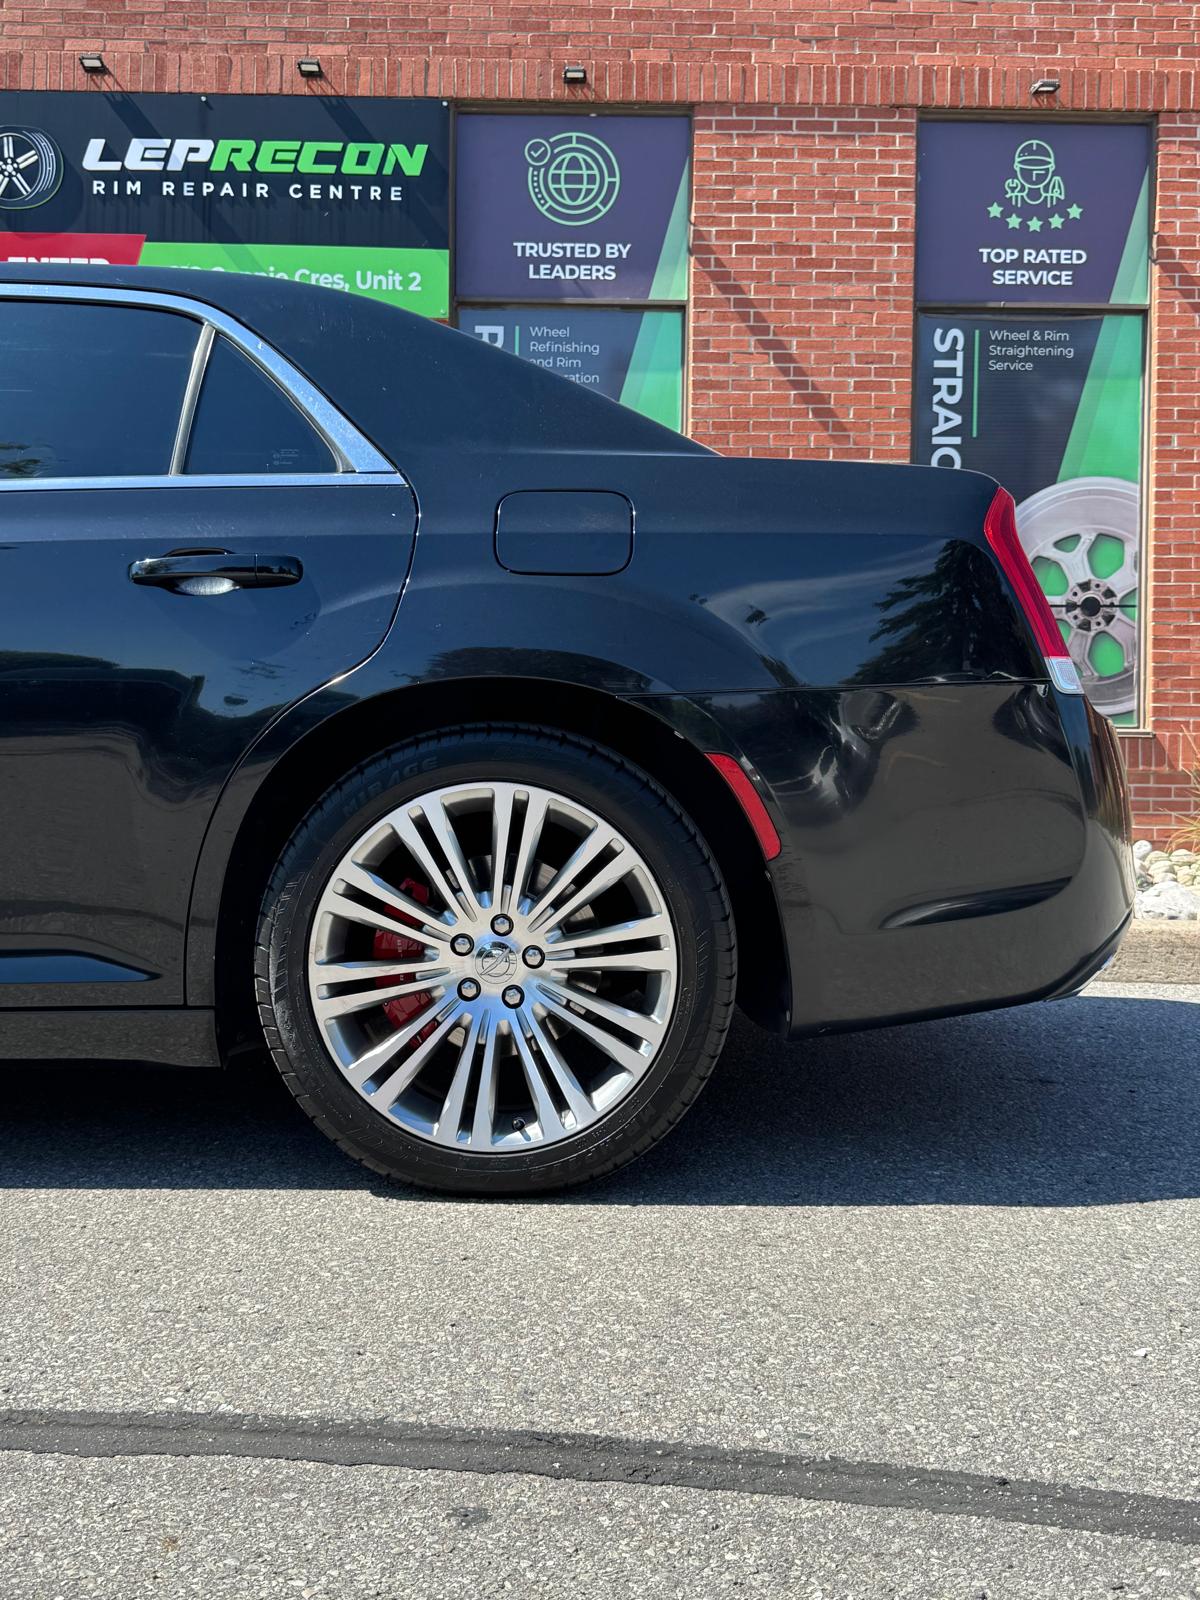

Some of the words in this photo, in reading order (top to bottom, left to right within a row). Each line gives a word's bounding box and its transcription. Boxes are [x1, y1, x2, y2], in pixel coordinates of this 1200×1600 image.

[82, 138, 429, 177] LEPRECON
[92, 180, 142, 196] RIM
[162, 181, 269, 198] REPAIR
[289, 183, 402, 201] CENTRE
[513, 242, 601, 258] TRUSTED
[605, 244, 632, 259] BY
[979, 248, 1019, 264] TOP
[1023, 249, 1087, 265] RATED
[294, 268, 350, 292] Cres,
[356, 269, 404, 290] Unit
[407, 271, 422, 291] 2
[528, 264, 616, 281] LEADERS
[992, 269, 1073, 286] SERVICE
[529, 326, 570, 338] Wheel
[989, 330, 1030, 341] Wheel
[1033, 331, 1042, 341] &
[1044, 330, 1070, 341] Rim
[529, 341, 600, 356] Refinishing
[988, 345, 1075, 359] Straightening
[556, 356, 582, 368] Rim
[988, 359, 1034, 371] Service
